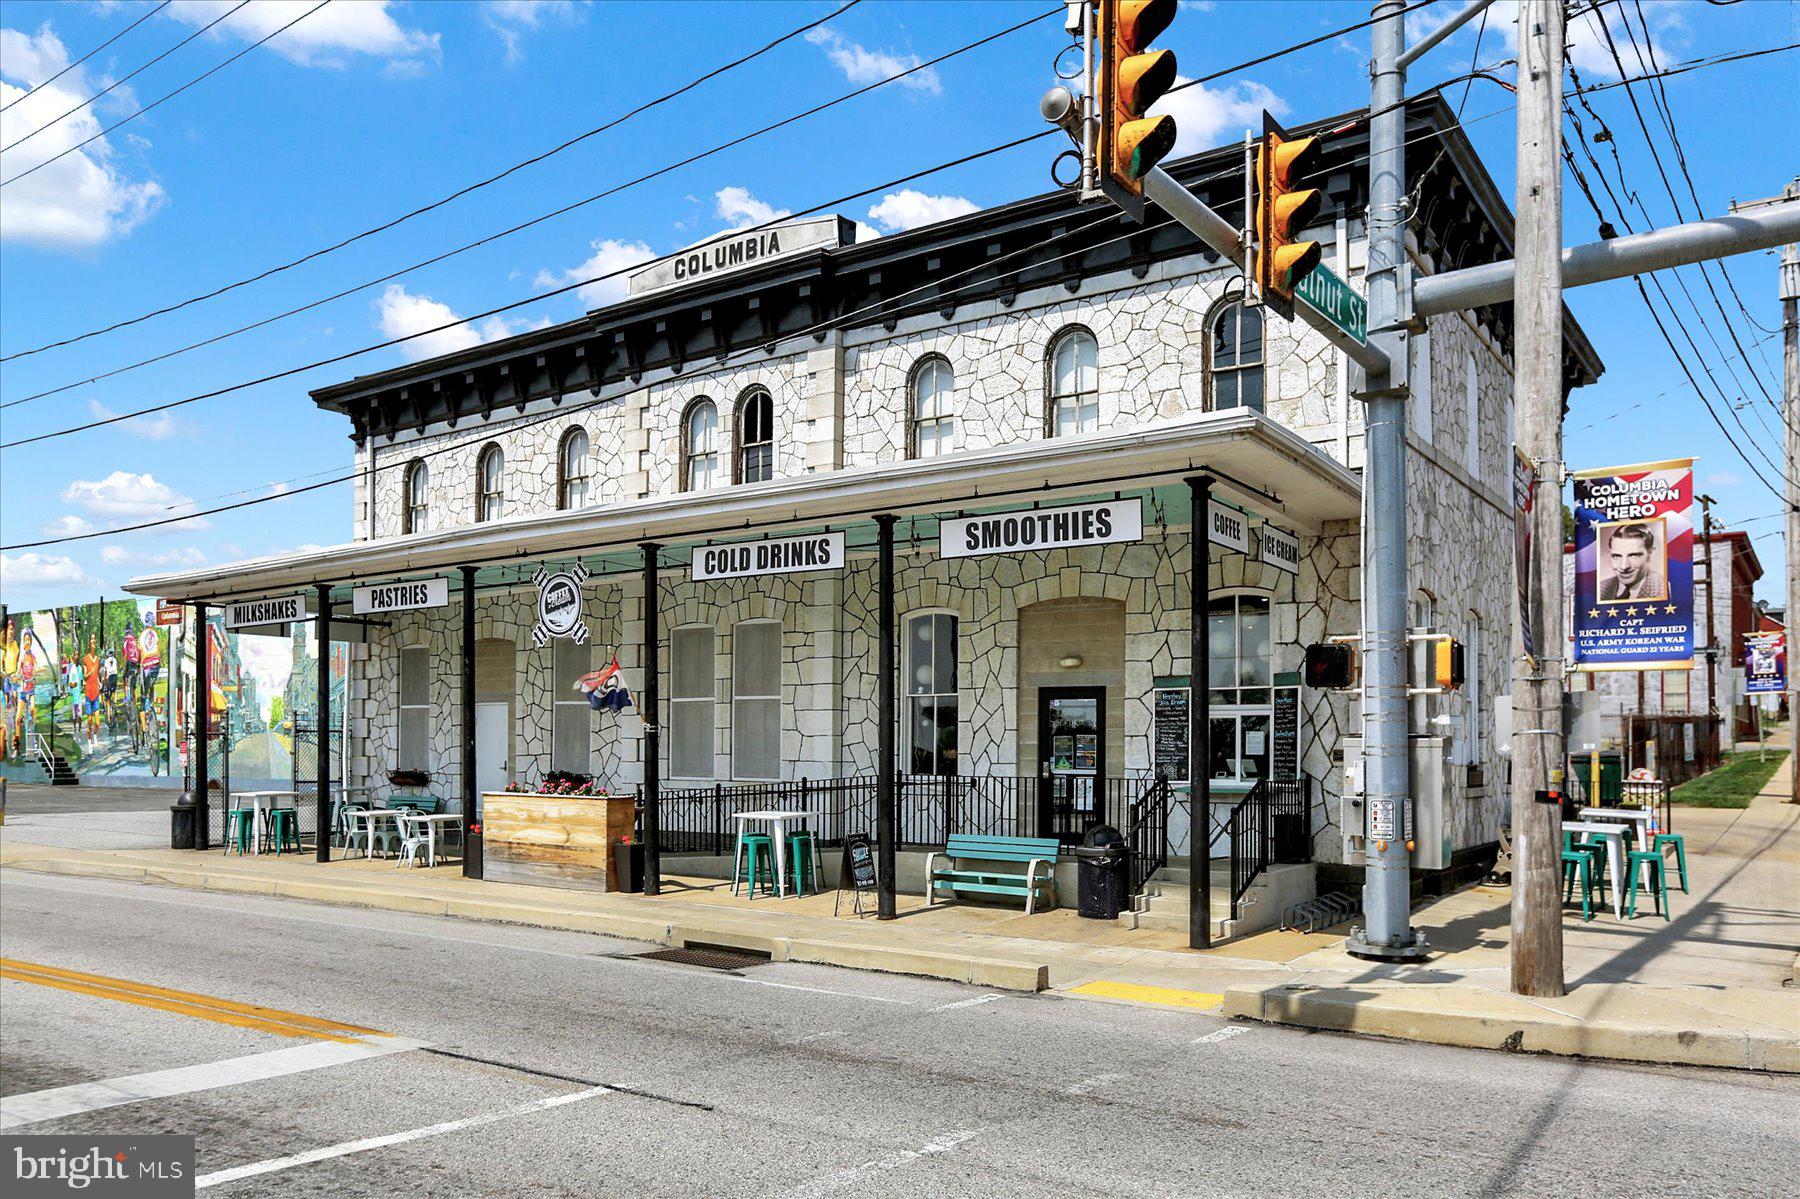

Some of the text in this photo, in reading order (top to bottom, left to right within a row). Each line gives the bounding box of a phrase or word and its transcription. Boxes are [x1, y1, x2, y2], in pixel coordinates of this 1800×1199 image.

[674, 231, 781, 280] COLUMBIA
[1299, 269, 1363, 338] alnut St
[1584, 489, 1680, 509] HOMETOWN
[1591, 479, 1668, 496] COLUMBIA
[1606, 503, 1656, 519] HERO
[965, 507, 1112, 551] SMOOTHIES
[1214, 512, 1241, 541] COFFEE
[704, 538, 830, 575] COLD DRINKS
[1264, 533, 1298, 565] ICE CREAM
[371, 583, 428, 609] PASTRIES
[233, 599, 298, 625] MILKSHAKES
[1619, 619, 1645, 627] CAPT
[1579, 625, 1687, 637] RICHARD K. SEIFRIED
[1625, 637, 1663, 645] KOREAN
[1620, 646, 1648, 654] GUARD
